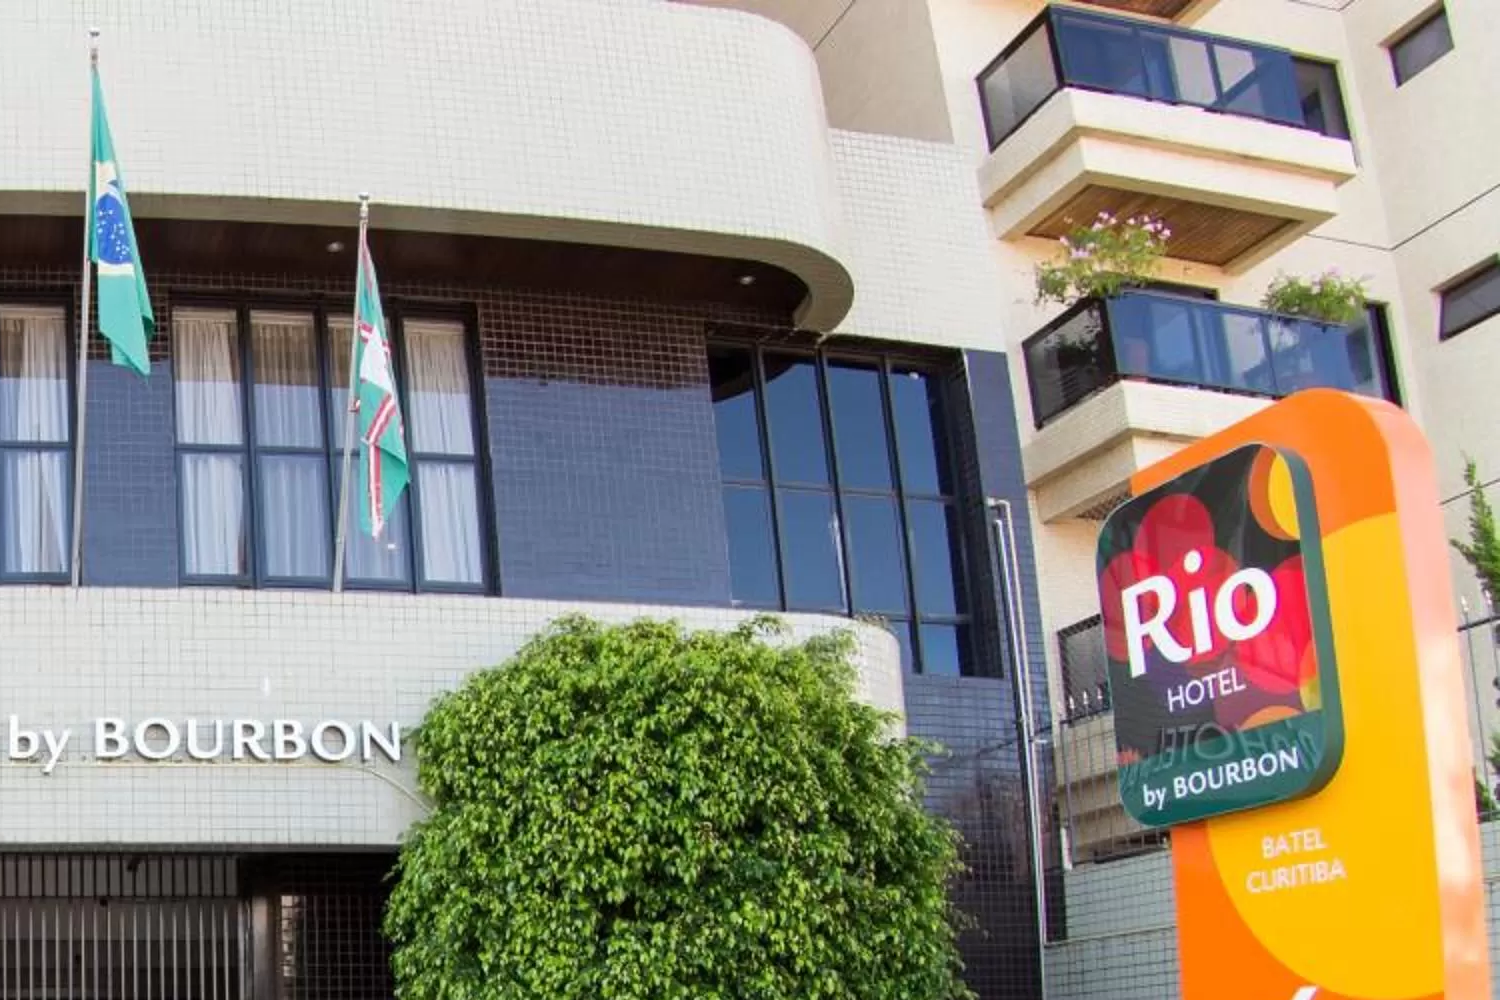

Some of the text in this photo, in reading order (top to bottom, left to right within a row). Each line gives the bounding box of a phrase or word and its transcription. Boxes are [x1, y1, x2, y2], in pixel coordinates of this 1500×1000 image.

[1121, 550, 1277, 678] Rio
[1167, 668, 1247, 712] HOTEL
[8, 714, 72, 774] by
[95, 718, 401, 763] BOURBON
[1142, 784, 1167, 810] by
[1173, 747, 1300, 799] BOURBON
[1261, 828, 1327, 859] BATEL
[1245, 859, 1348, 894] CURITIBA
